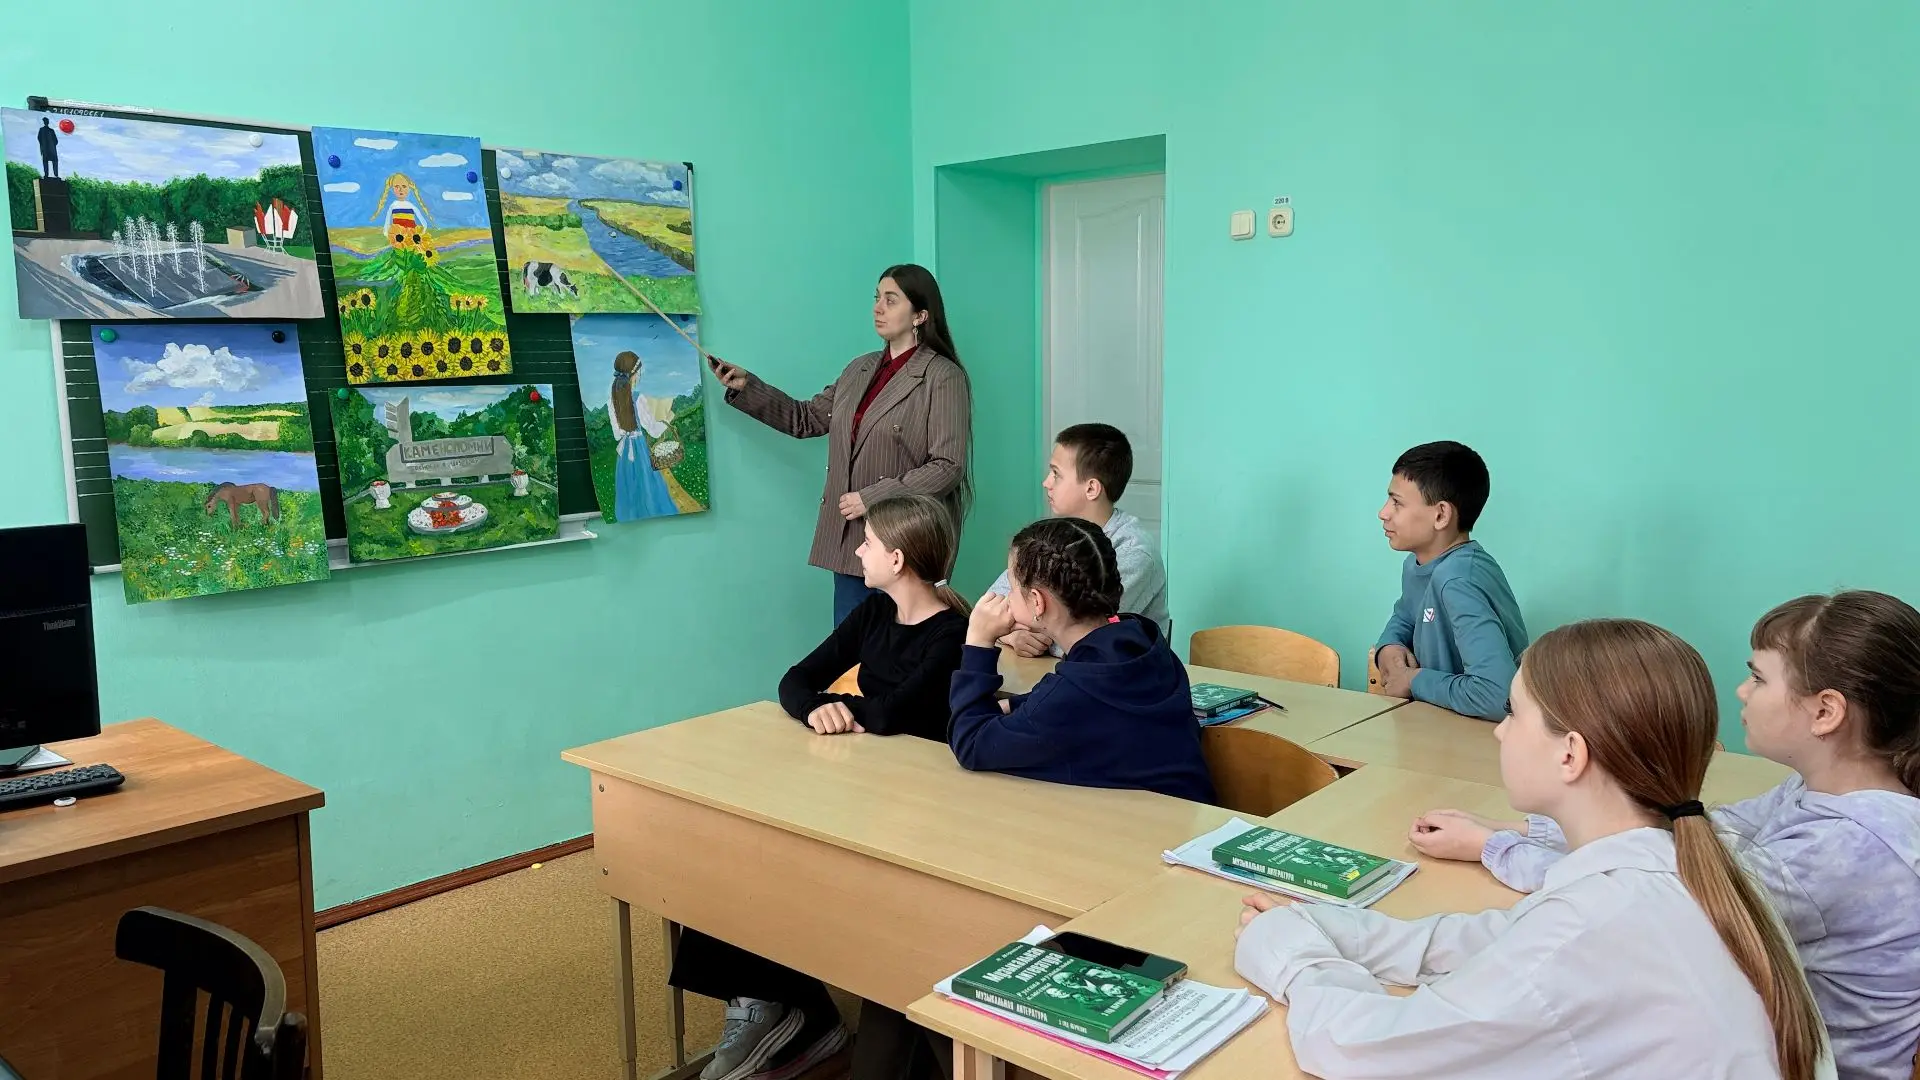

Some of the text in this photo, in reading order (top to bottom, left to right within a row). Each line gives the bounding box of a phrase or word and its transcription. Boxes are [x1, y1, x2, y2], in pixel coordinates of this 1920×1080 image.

[1274, 197, 1285, 205] 220
[42, 619, 76, 631] ThinkVision
[1232, 856, 1266, 873] МУЗЫКАЛЬНАЯ
[975, 989, 1014, 1011] МУЗЫКАЛЬНАЯ
[1016, 1003, 1048, 1022] ЛИТЕРАТУРА
